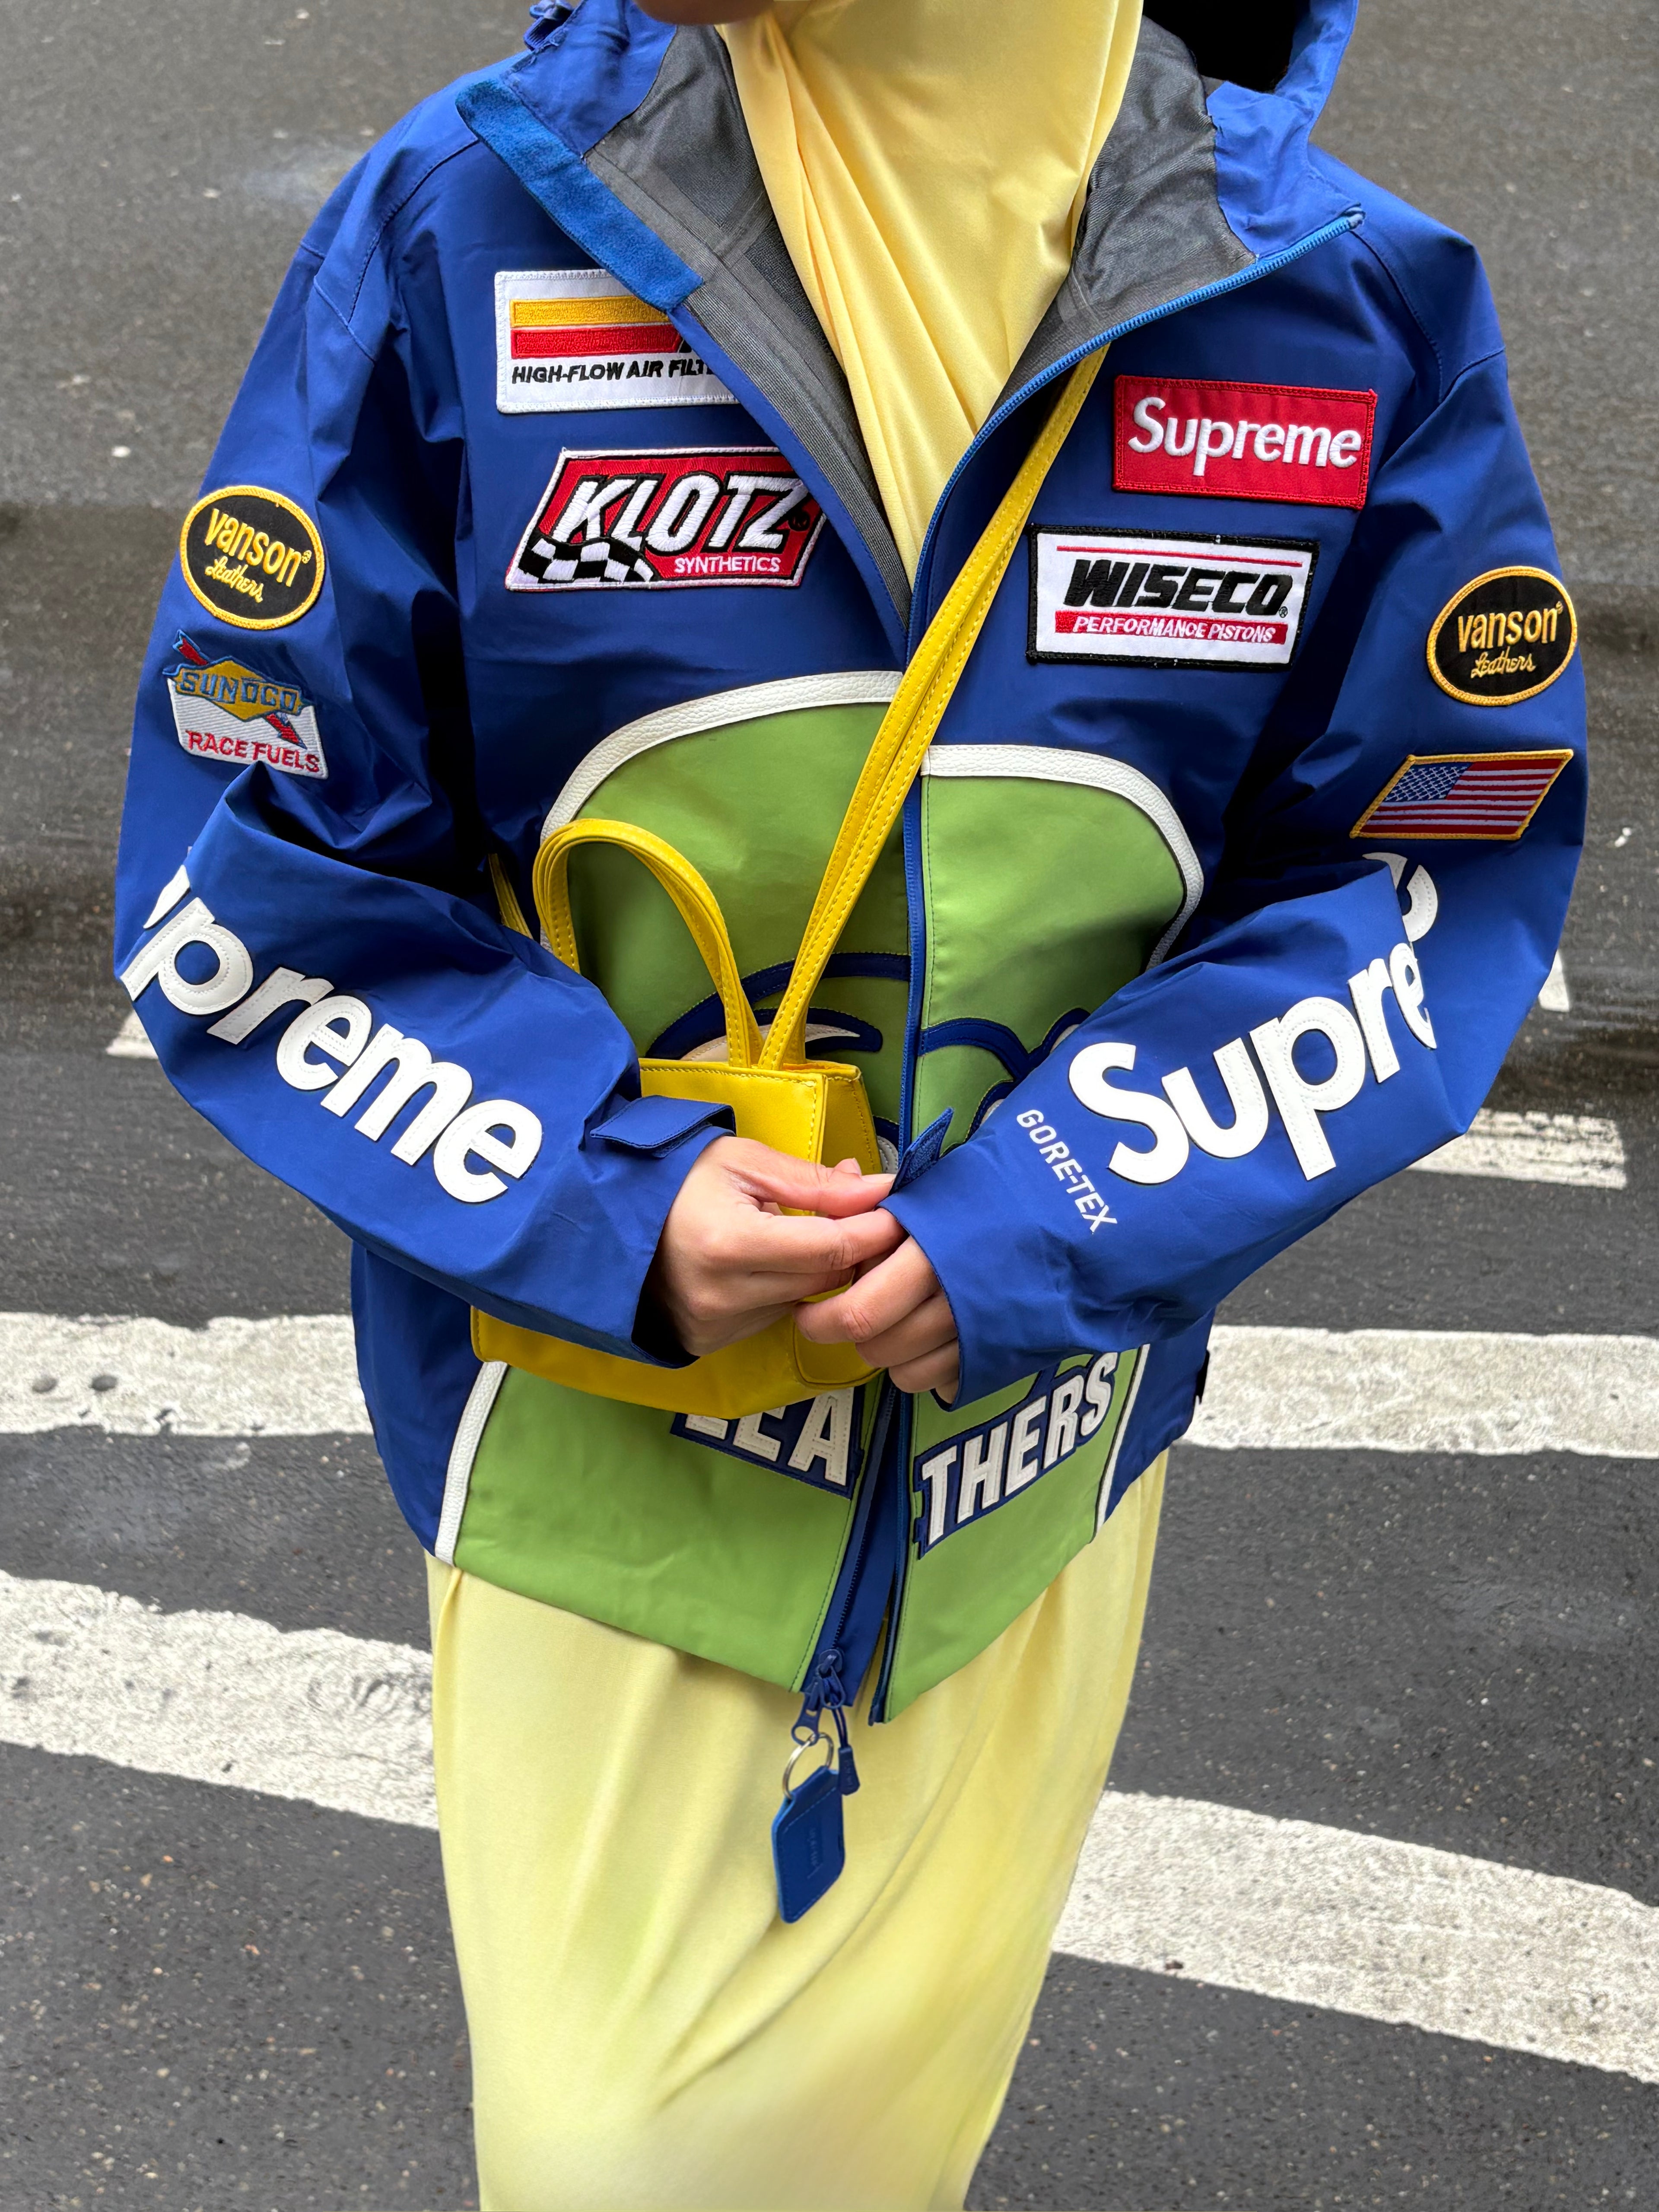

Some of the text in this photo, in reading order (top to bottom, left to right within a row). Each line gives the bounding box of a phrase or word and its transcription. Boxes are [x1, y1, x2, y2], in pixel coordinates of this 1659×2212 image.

[512, 359, 713, 384] HIGH-FLOW AIR FILT
[1128, 397, 1362, 477] Supreme
[552, 474, 810, 551] KLOTZ
[674, 556, 782, 574] SYNTHETICS
[1063, 559, 1293, 616] WISECO
[1073, 616, 1276, 643] PERFORMANCE PISTONS
[180, 671, 298, 711] SUNOCO
[185, 730, 320, 772] RACE FUELS
[121, 864, 543, 1203] preme
[1017, 1109, 1118, 1232] GORE-TEX
[922, 1352, 1118, 1546] THERS
